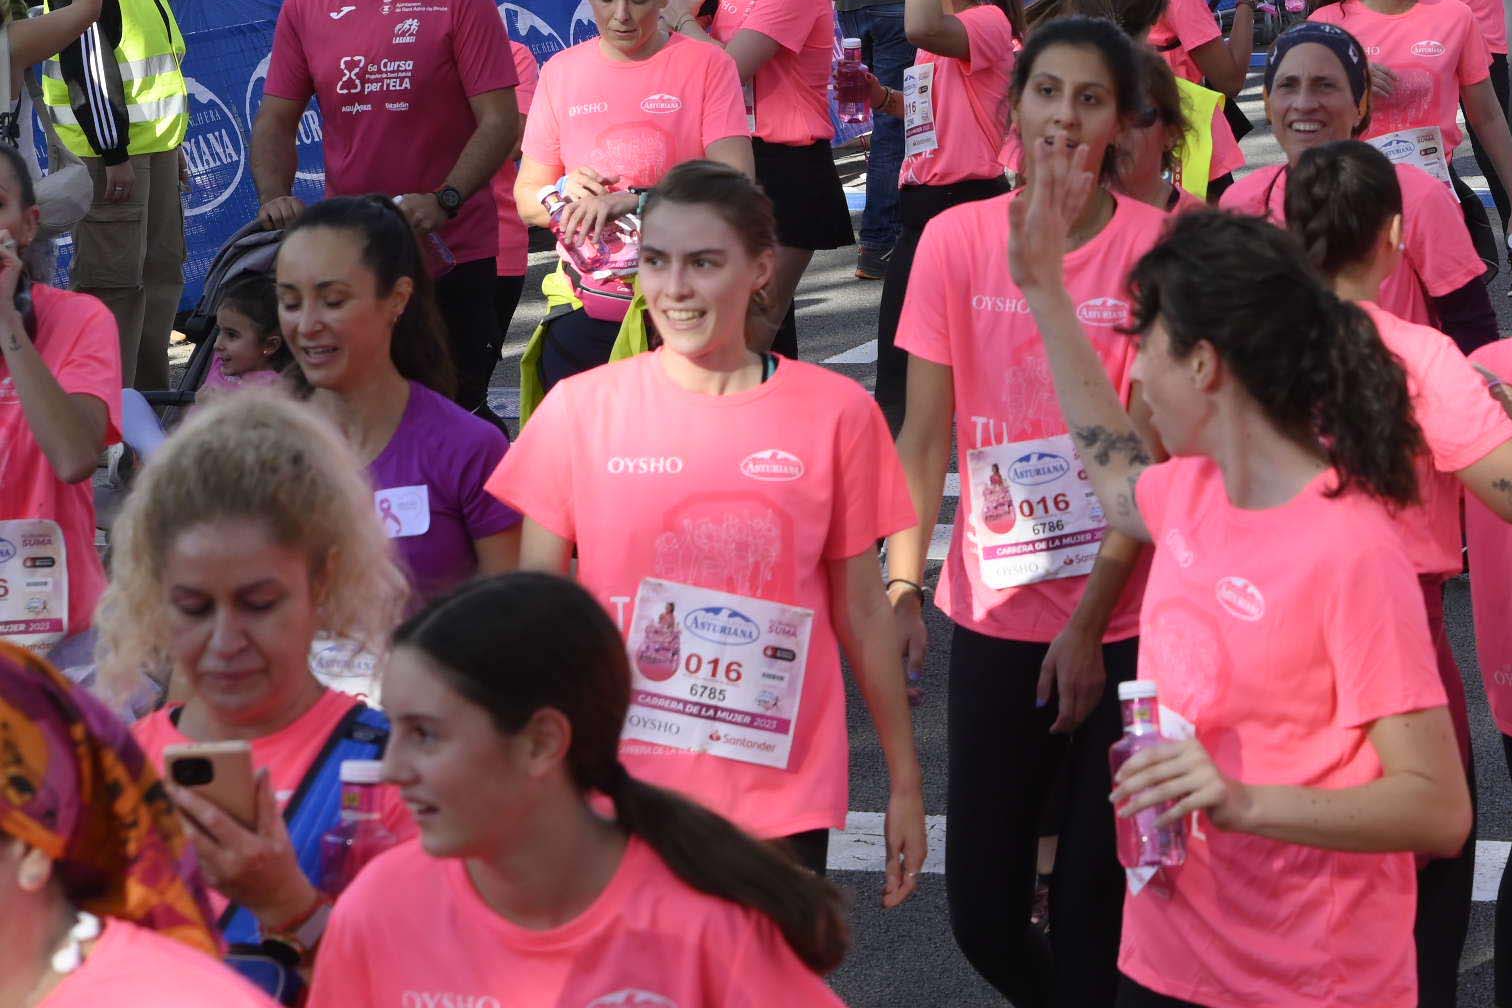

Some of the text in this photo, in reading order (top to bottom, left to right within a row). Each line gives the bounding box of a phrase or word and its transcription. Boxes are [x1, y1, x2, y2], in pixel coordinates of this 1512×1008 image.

[380, 58, 414, 71] Cursa
[364, 78, 411, 94] per l'ELA
[971, 416, 1009, 447] TU
[607, 456, 684, 475] OYSHO
[746, 462, 801, 476] ASTURIANA
[1012, 463, 1065, 480] ASTURIANA
[1019, 492, 1071, 518] 016
[1032, 519, 1065, 536] 6786
[996, 543, 1034, 556] CARRERA
[1035, 540, 1047, 550] DE
[1049, 538, 1061, 548] LA
[689, 616, 753, 640] ASTURIANA
[684, 652, 744, 683] 016
[689, 683, 727, 702] 6785
[637, 694, 684, 712] CARRERA
[685, 704, 700, 715] DE
[701, 706, 716, 718] LA
[716, 709, 752, 725] MUJER
[628, 713, 681, 736] OYSHO
[723, 733, 776, 753] Santander
